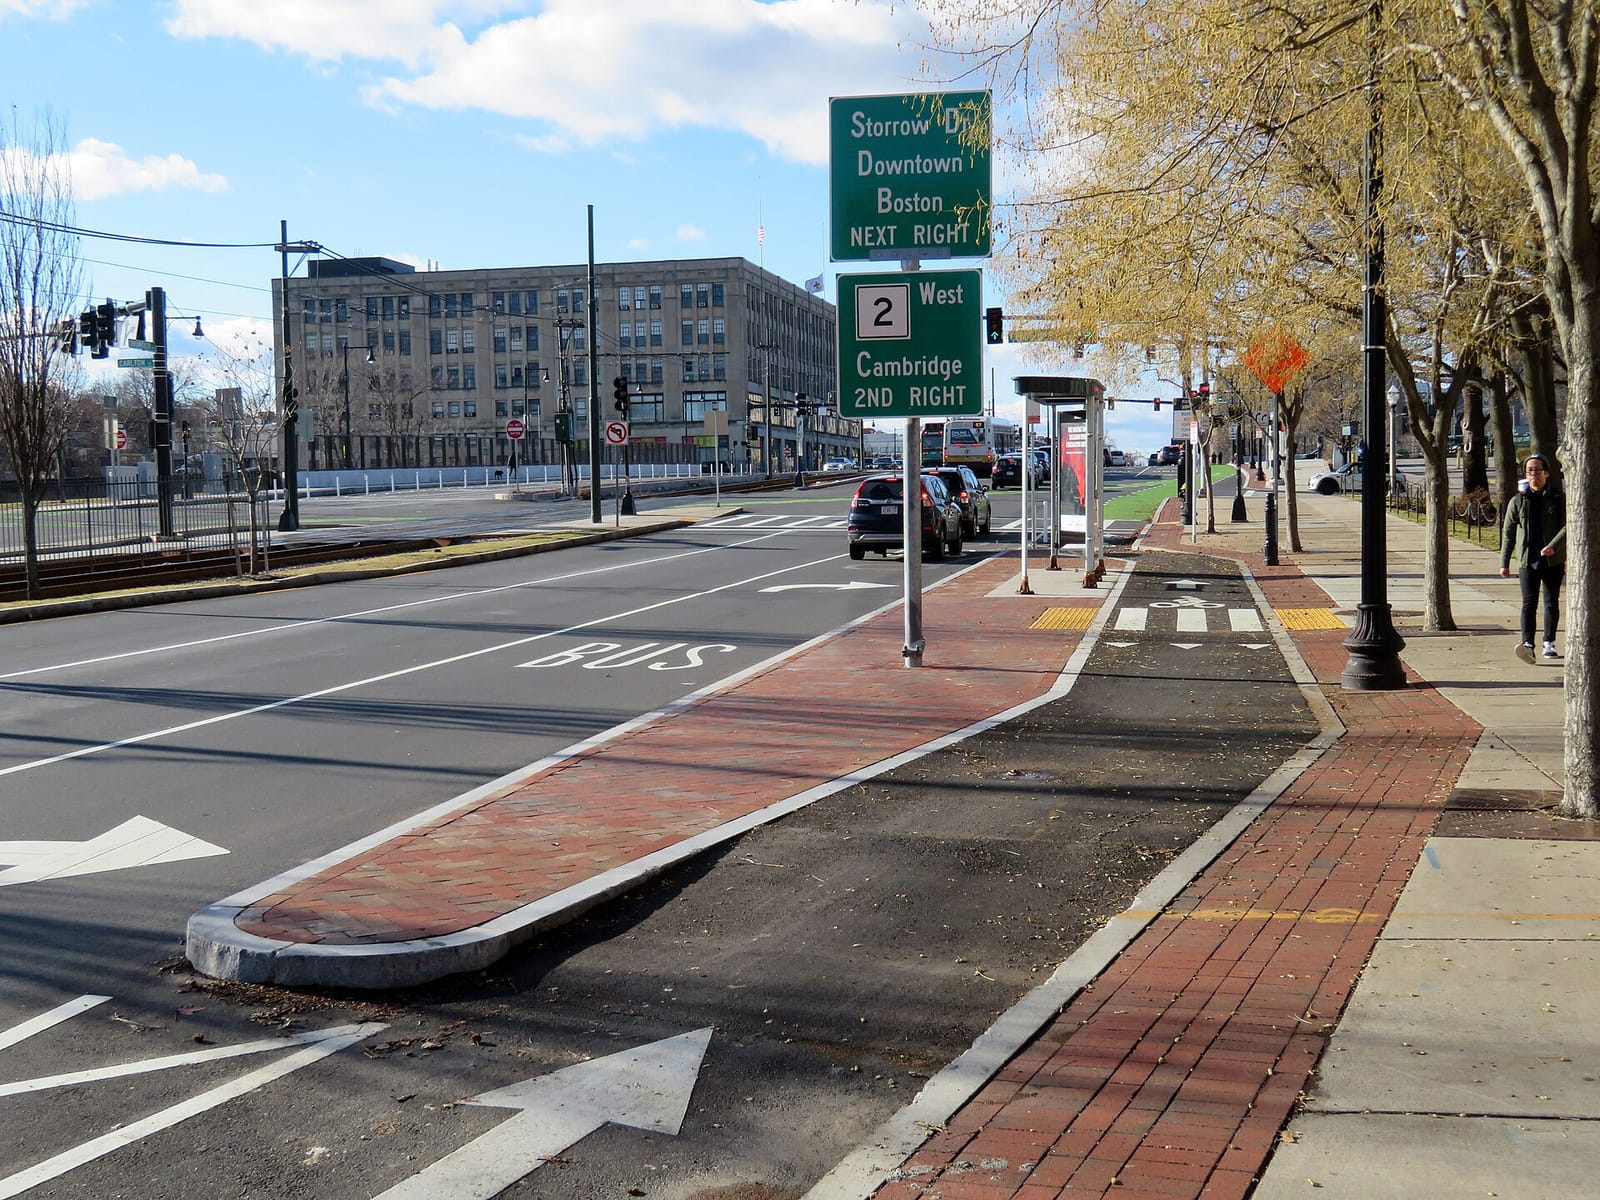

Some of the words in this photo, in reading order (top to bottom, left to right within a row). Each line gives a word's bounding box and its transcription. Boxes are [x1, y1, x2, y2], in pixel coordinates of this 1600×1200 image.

[850, 111, 929, 137] Storrow
[858, 150, 962, 176] Downtown
[877, 188, 943, 214] Boston
[850, 226, 897, 246] NEXT
[913, 223, 969, 244] RIGHT
[919, 282, 963, 304] West
[873, 297, 893, 326] 2
[856, 351, 962, 380] Cambridge
[854, 387, 893, 408] 2ND
[909, 385, 966, 407] RIGHT
[513, 642, 738, 671] BUS
